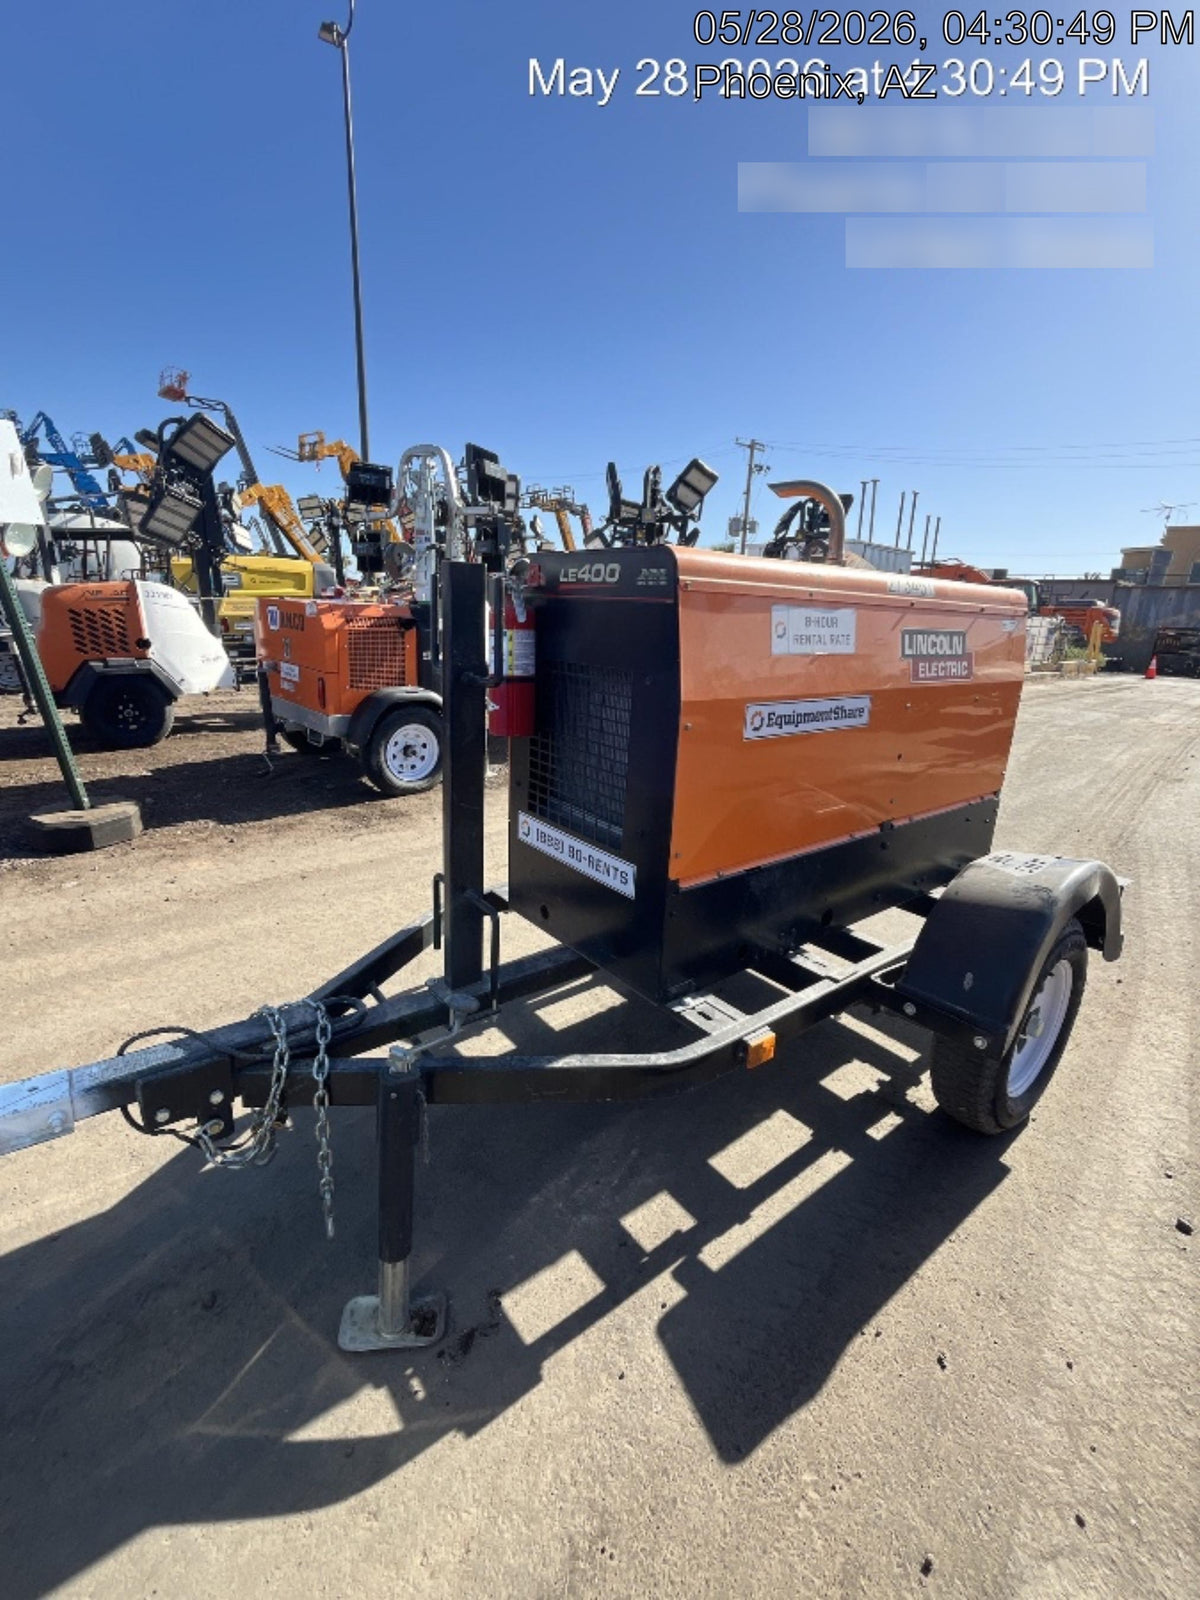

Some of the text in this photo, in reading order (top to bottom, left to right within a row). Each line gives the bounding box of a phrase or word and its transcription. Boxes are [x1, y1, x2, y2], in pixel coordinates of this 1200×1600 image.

[559, 563, 622, 583] LE400
[792, 633, 851, 646] RENTAL RATE
[904, 633, 964, 655] LINCOLN
[918, 661, 968, 678] ELECTRIC
[766, 705, 866, 729] EquipmentShare
